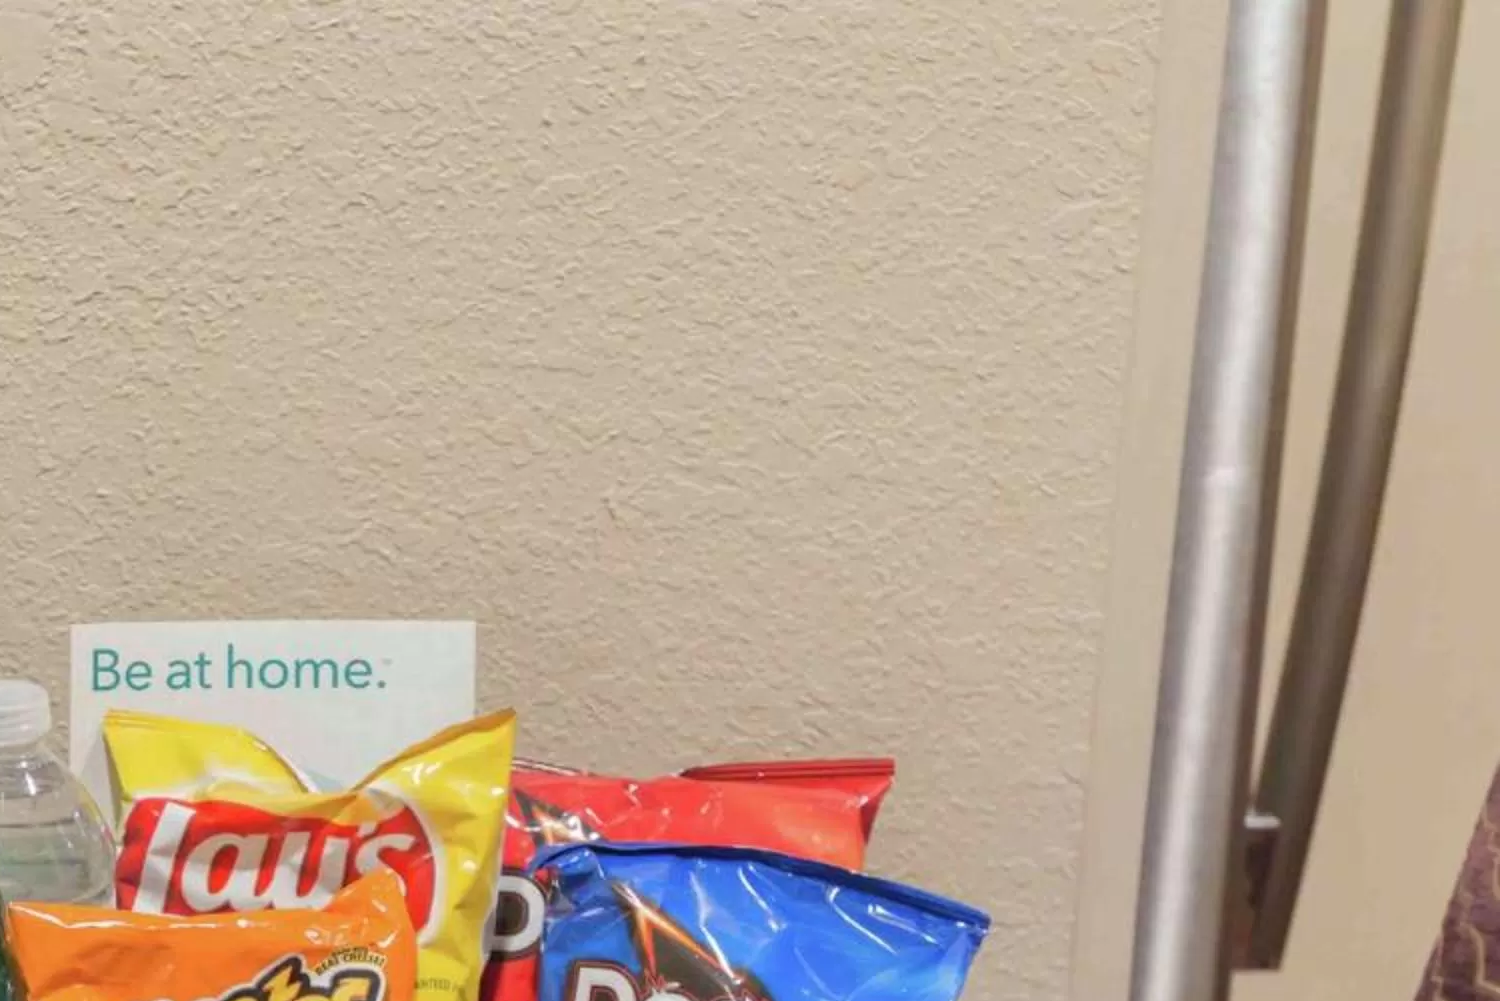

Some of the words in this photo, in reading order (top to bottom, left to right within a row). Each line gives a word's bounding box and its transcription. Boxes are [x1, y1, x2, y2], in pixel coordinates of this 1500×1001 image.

[91, 648, 153, 692] Be
[167, 652, 213, 689] at
[227, 644, 388, 689] home.
